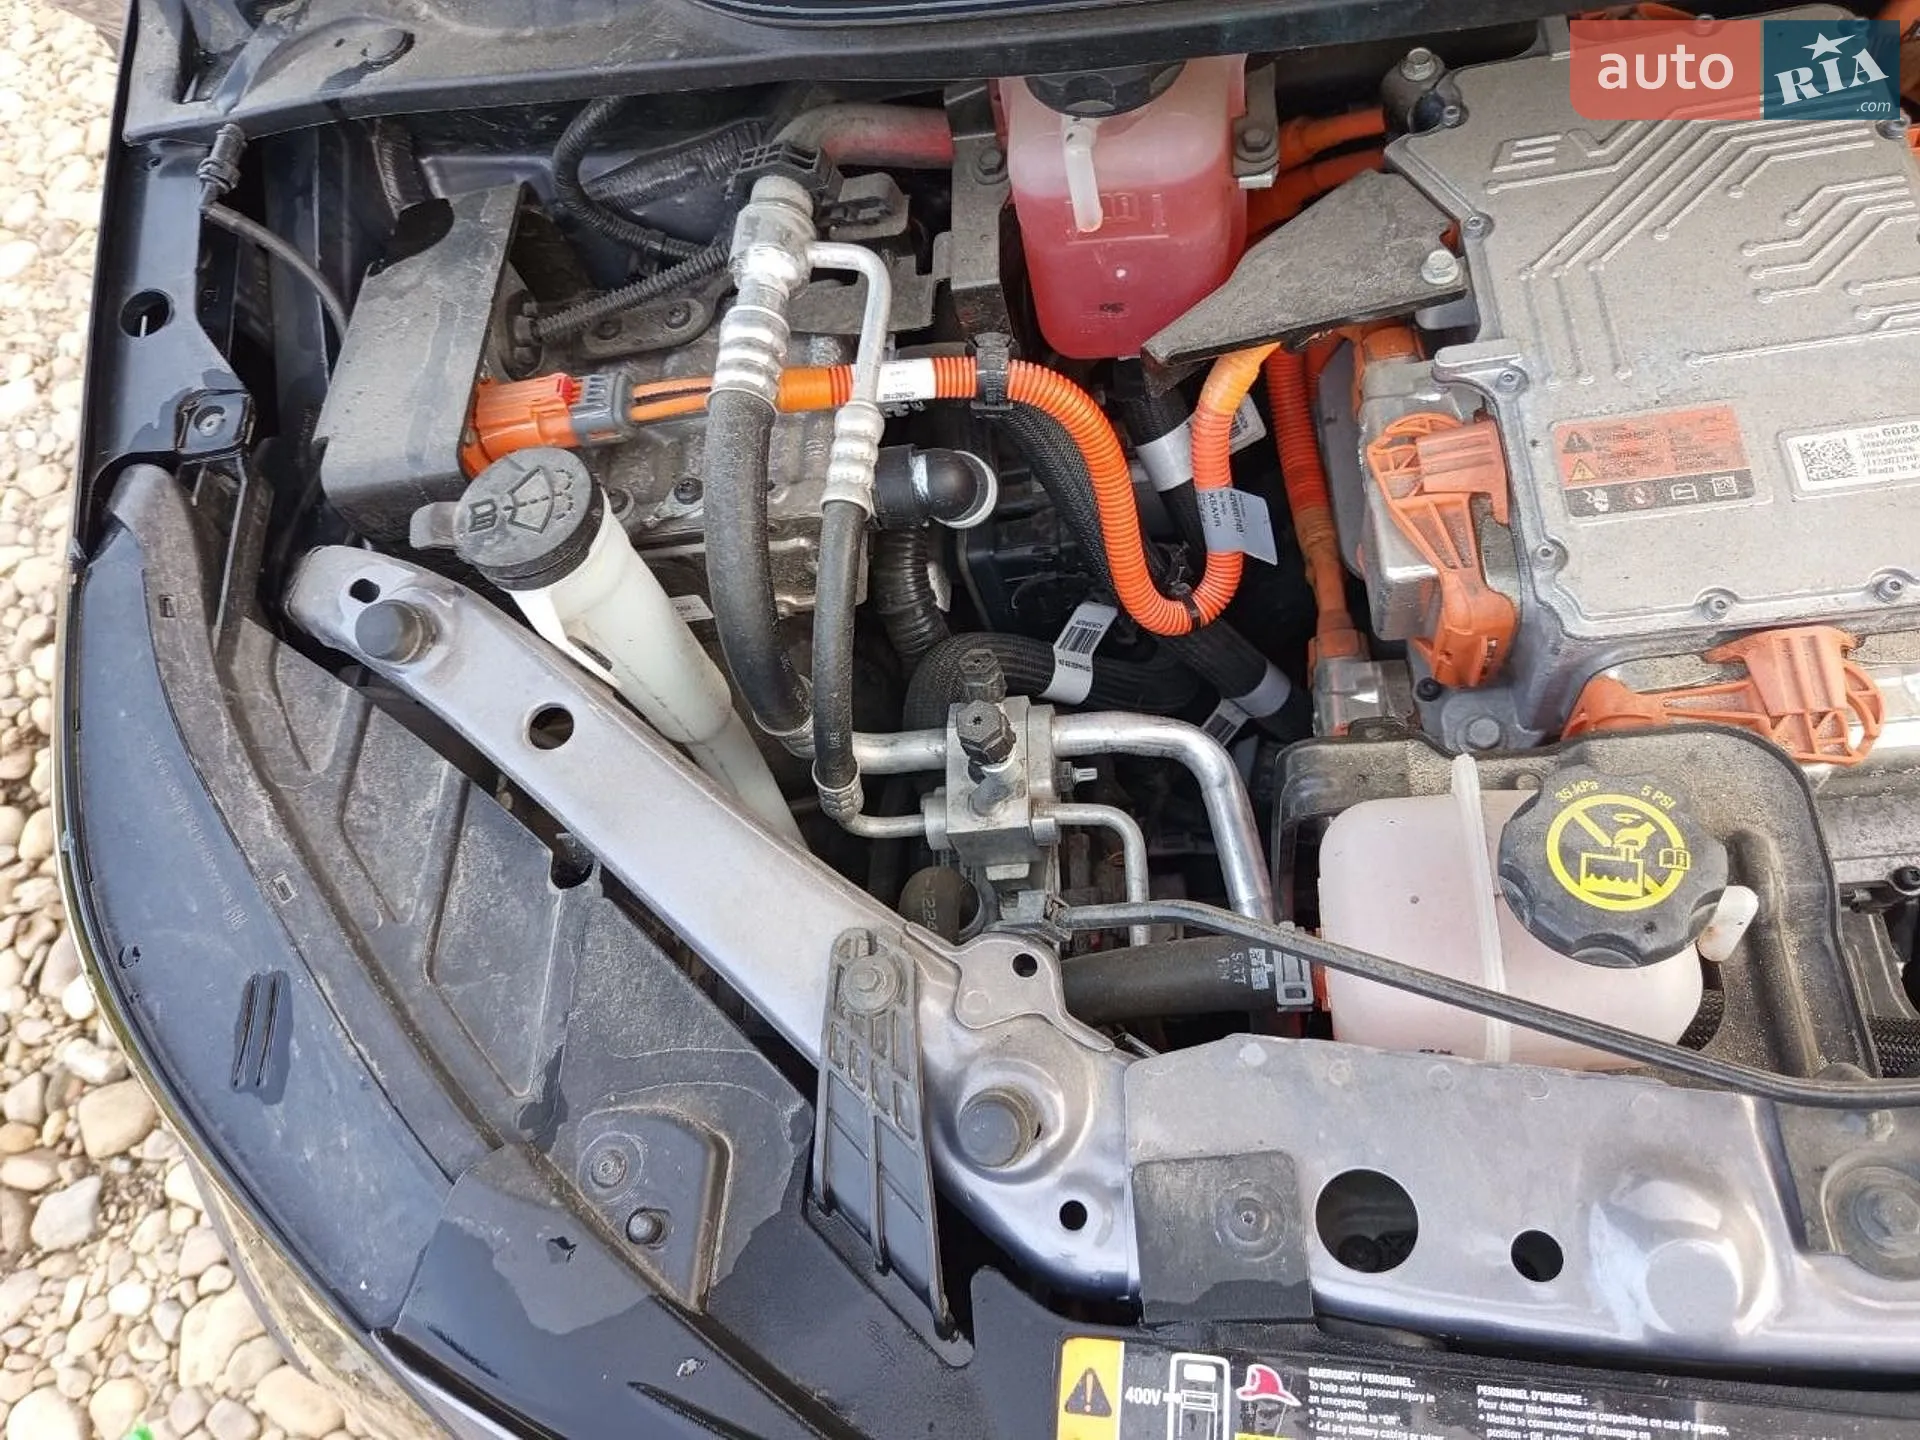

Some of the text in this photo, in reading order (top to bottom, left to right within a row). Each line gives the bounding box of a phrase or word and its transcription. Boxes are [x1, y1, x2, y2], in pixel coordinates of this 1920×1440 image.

[1641, 785, 1651, 797] 5
[1308, 1367, 1360, 1382] EMERGENCY
[1125, 1387, 1162, 1405] 400V
[1309, 1380, 1436, 1403] To help avoid personal injury in
[1308, 1395, 1320, 1404] an
[1316, 1407, 1335, 1418] Turn
[1477, 1399, 1497, 1411] Pour
[1649, 1417, 1662, 1428] en
